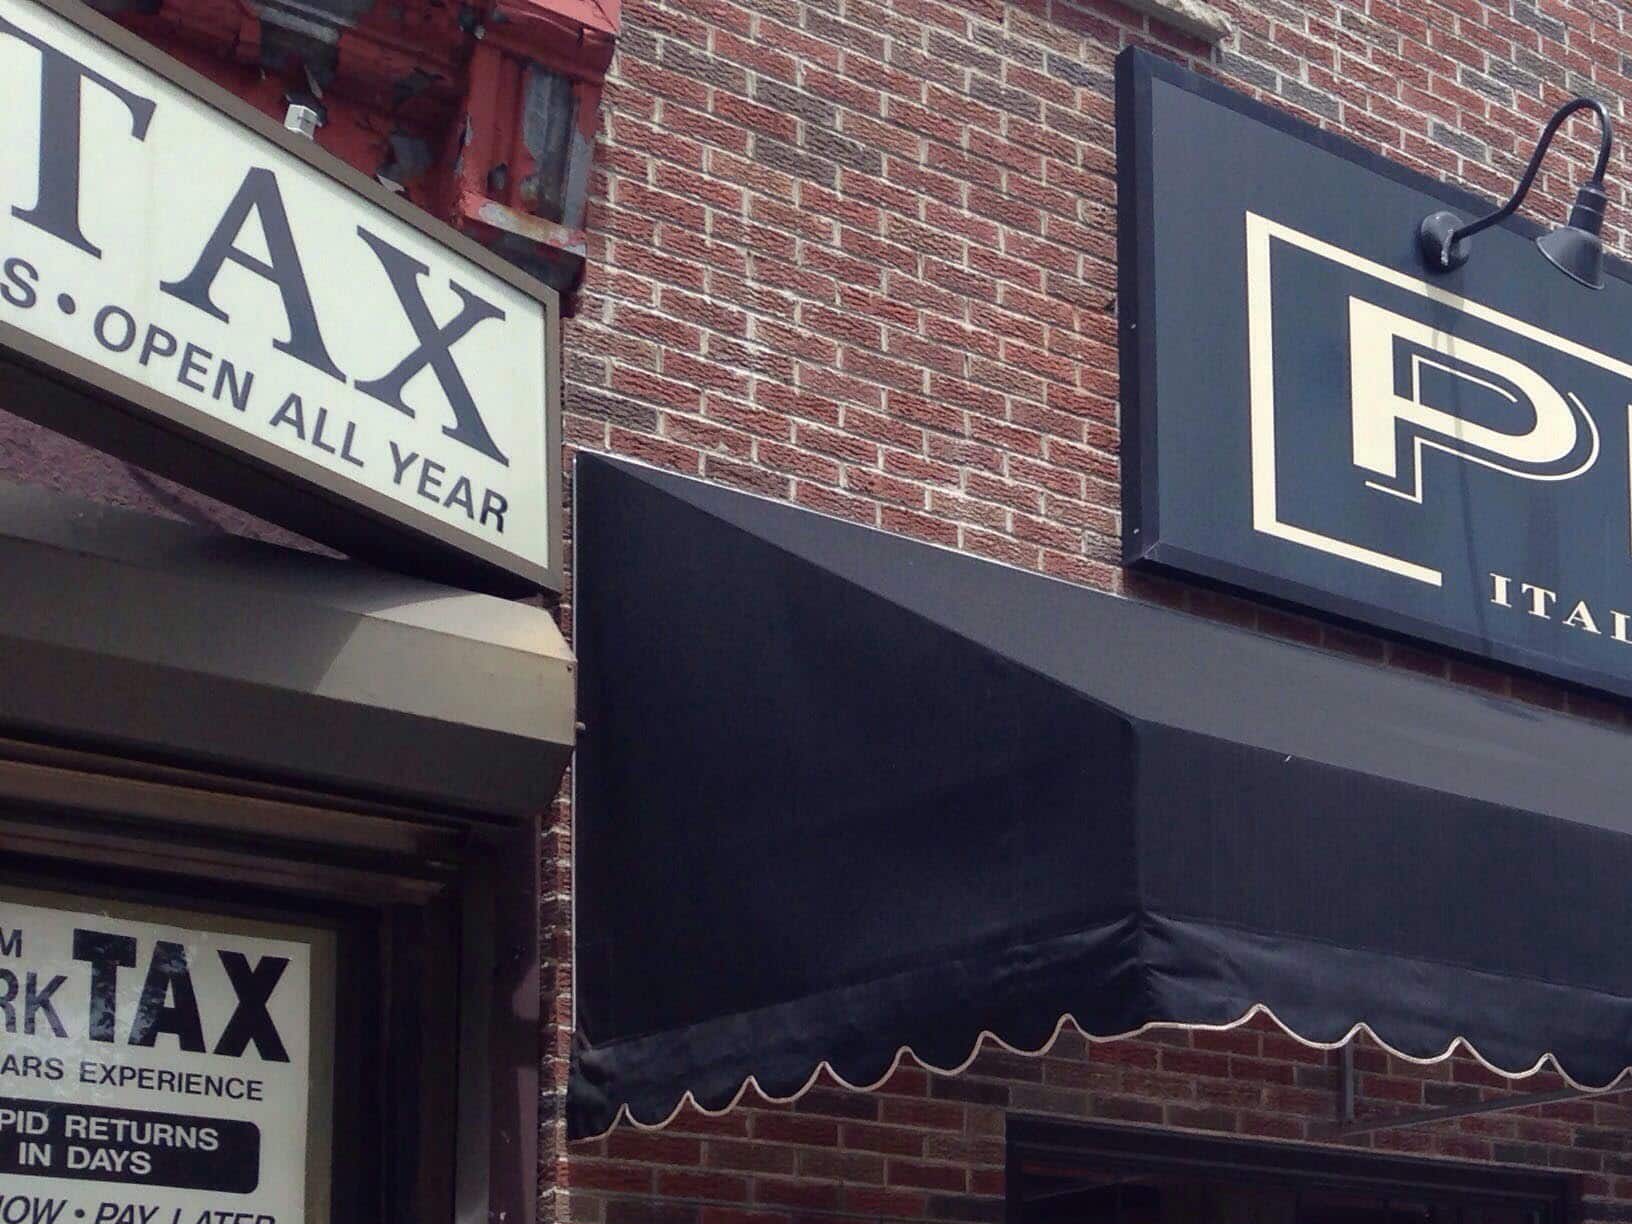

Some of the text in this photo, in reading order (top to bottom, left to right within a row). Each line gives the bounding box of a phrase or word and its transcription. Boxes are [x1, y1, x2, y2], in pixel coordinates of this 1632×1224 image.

[0, 15, 510, 467] TAX
[93, 304, 256, 413] OPEN
[269, 392, 365, 468] ALL
[389, 440, 510, 534] YEAR
[73, 927, 292, 1063] TAX
[79, 1061, 264, 1101] EXPERIENCE
[18, 1142, 152, 1175] IN DAYS
[64, 1117, 220, 1151] RETURNS
